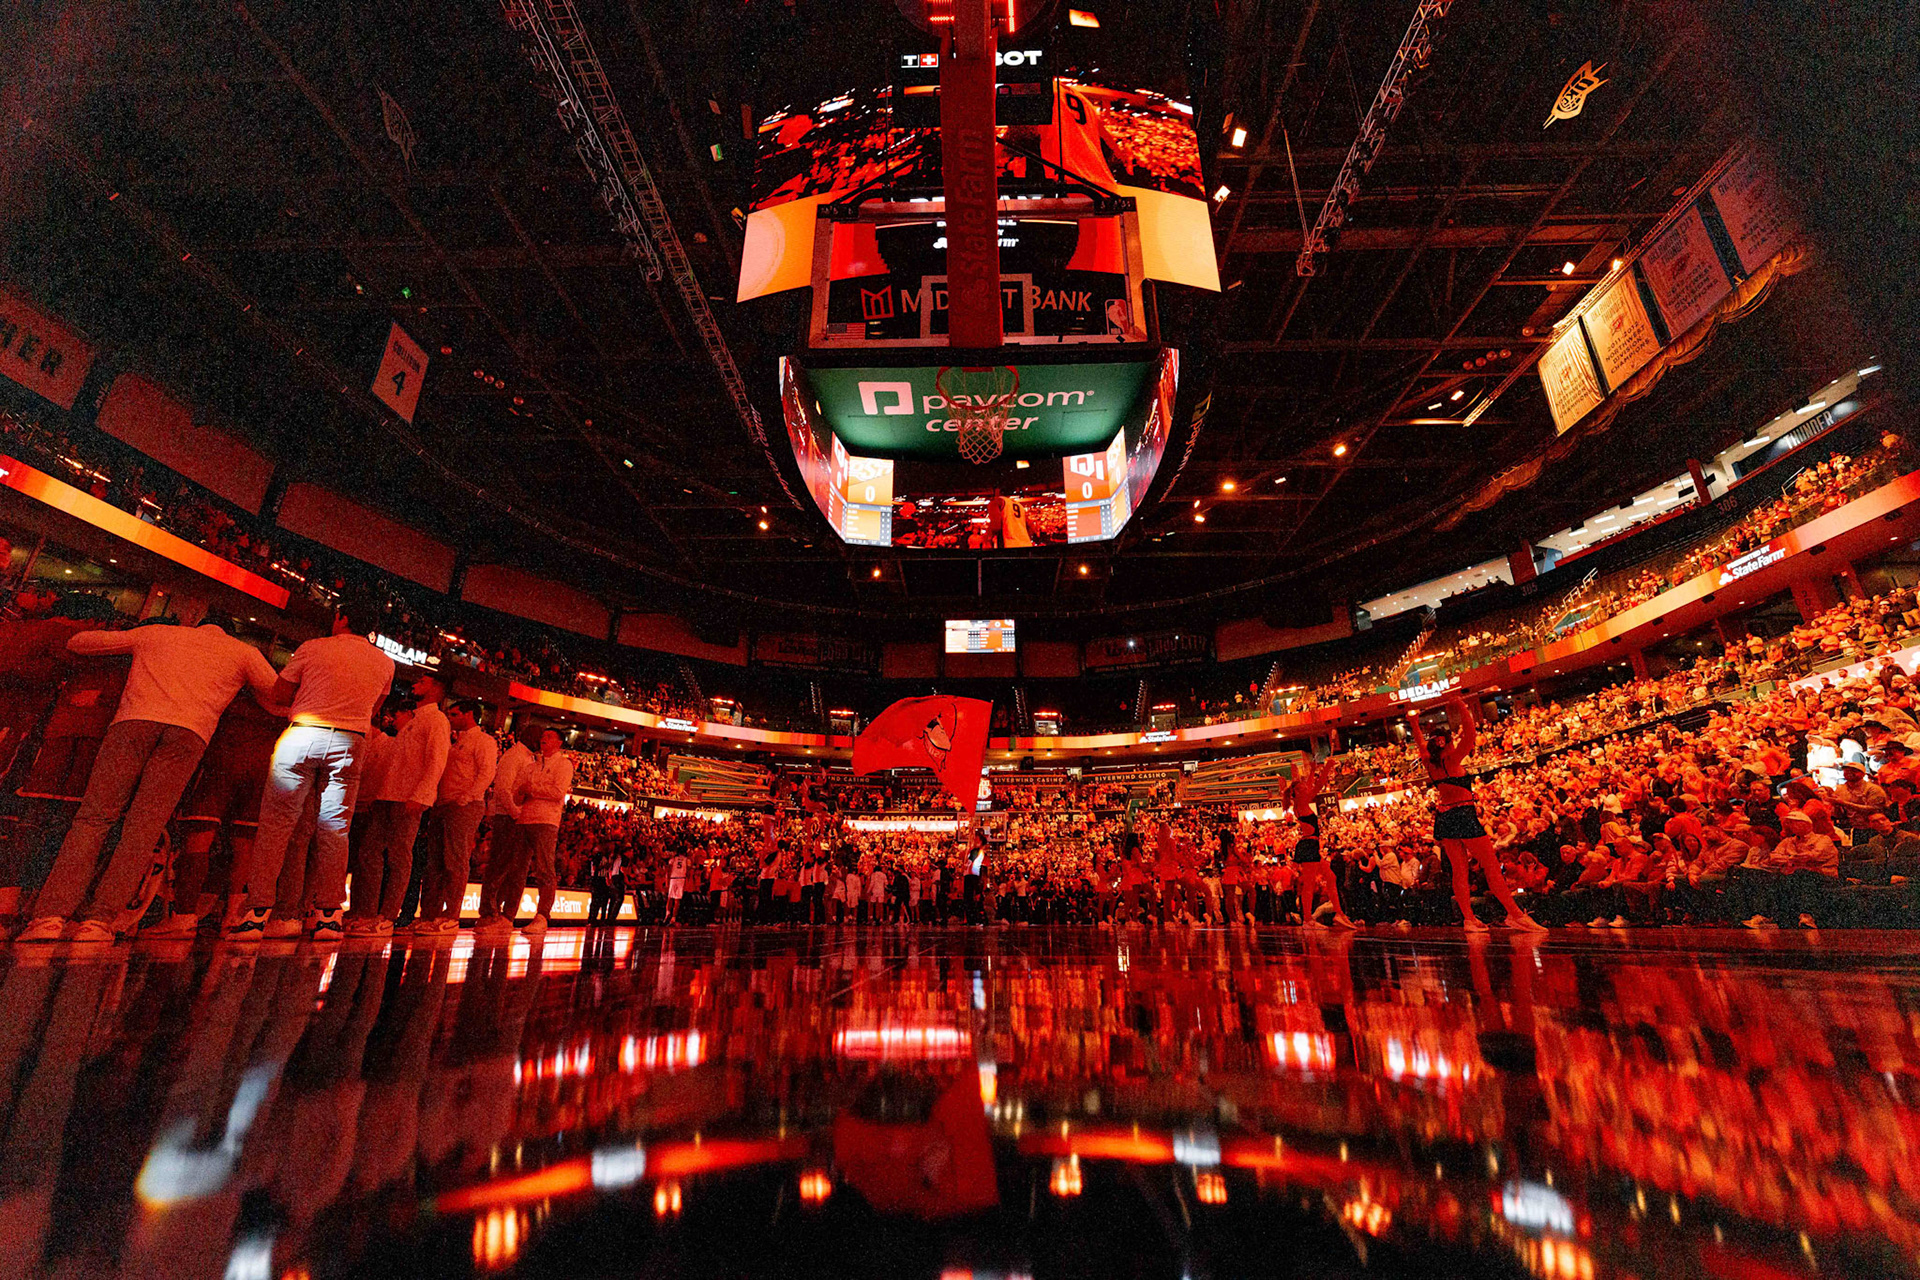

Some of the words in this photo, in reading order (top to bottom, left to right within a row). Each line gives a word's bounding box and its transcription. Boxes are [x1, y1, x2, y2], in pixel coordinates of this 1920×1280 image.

[1029, 285, 1092, 313] BANK
[1604, 324, 1646, 362] NORTHWEST
[1609, 338, 1651, 374] CHAMPIONS
[1612, 336, 1643, 364] DIVISION
[392, 371, 406, 396] 4
[925, 416, 1039, 432] center
[1783, 410, 1835, 450] THUNDER
[865, 486, 875, 502] 0
[1082, 482, 1093, 499] 0
[376, 633, 428, 665] BEDLAM
[1398, 678, 1450, 700] BEDLAM
[677, 861, 682, 869] 5
